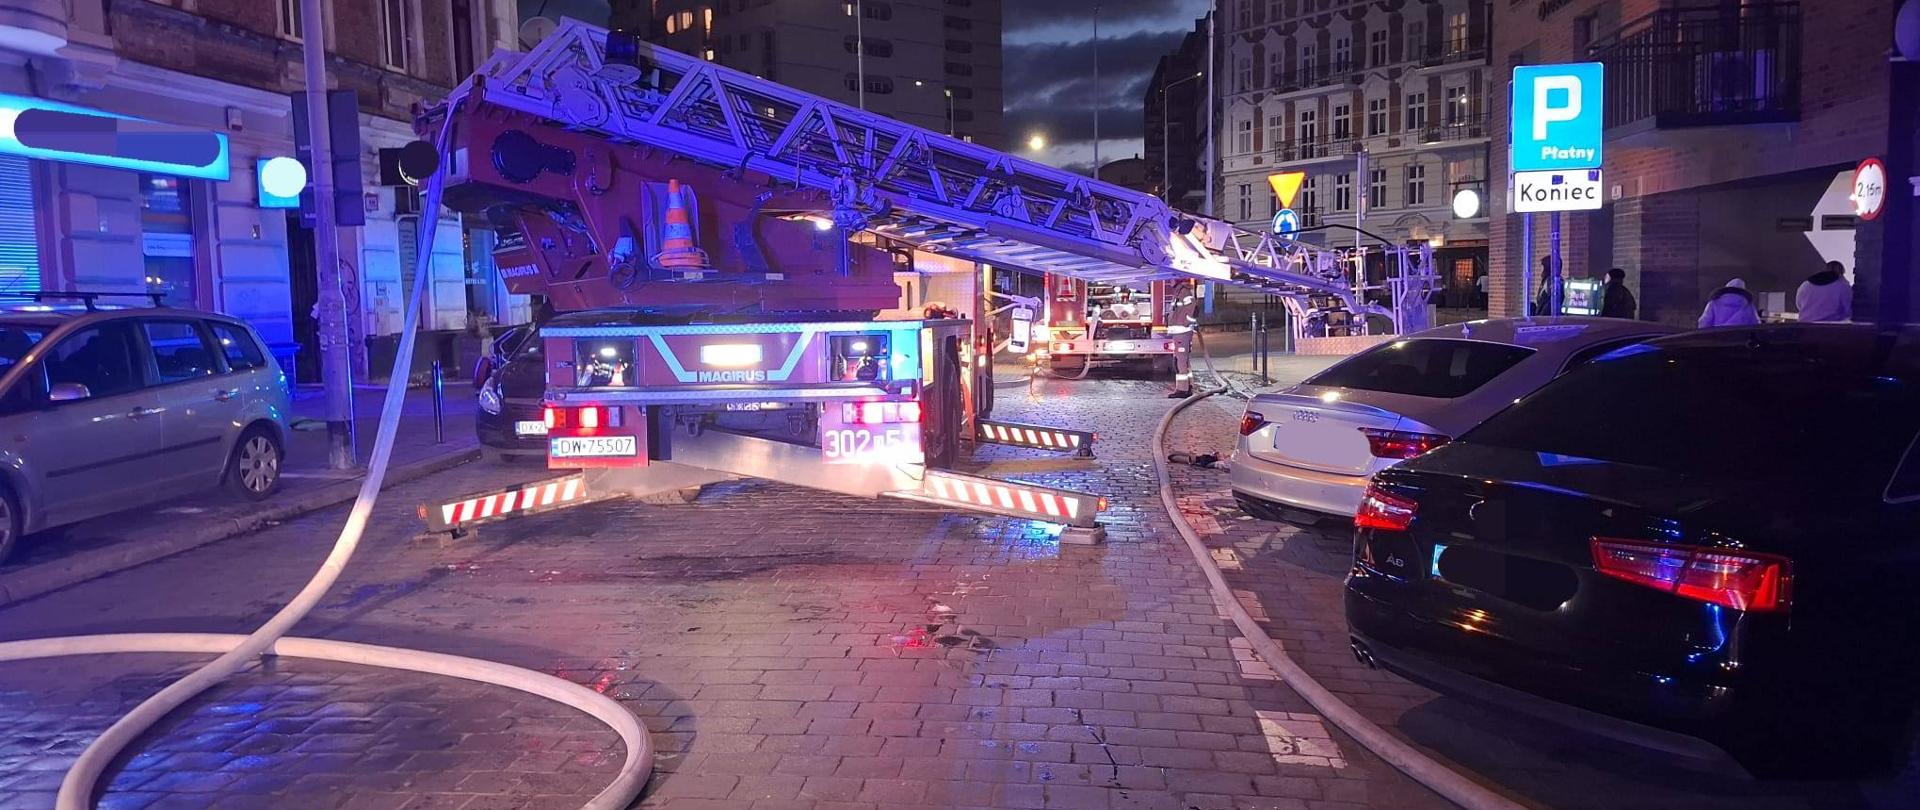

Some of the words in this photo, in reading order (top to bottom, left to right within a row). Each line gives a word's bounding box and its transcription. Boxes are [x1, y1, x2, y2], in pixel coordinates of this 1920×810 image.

[1532, 74, 1582, 141] P
[1541, 145, 1595, 162] Płatny
[1521, 182, 1595, 202] Koniec
[701, 370, 766, 382] MAGIRUS
[561, 440, 581, 454] DW
[588, 439, 632, 453] 75507
